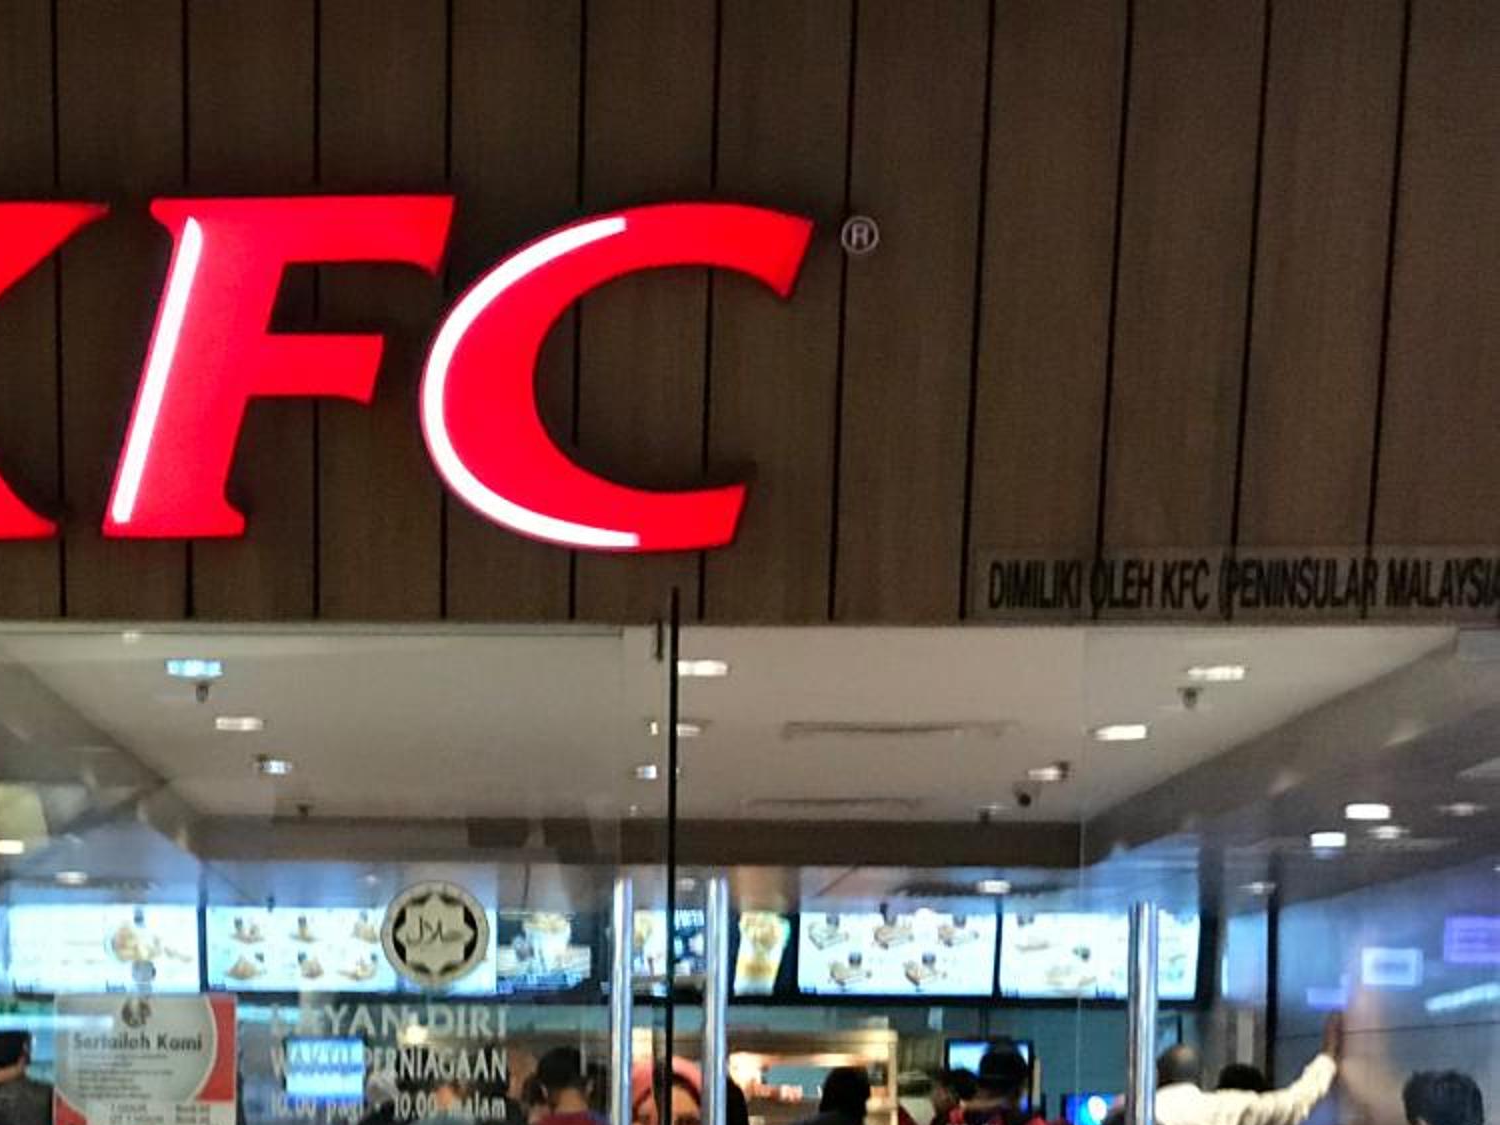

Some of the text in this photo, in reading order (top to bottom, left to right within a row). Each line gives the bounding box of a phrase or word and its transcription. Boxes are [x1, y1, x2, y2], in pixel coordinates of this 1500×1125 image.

[988, 559, 1082, 610] DIMILIKI
[1091, 558, 1154, 609] OLEH
[1161, 558, 1210, 611] KFC
[364, 1047, 508, 1082] PERNIAGAAN
